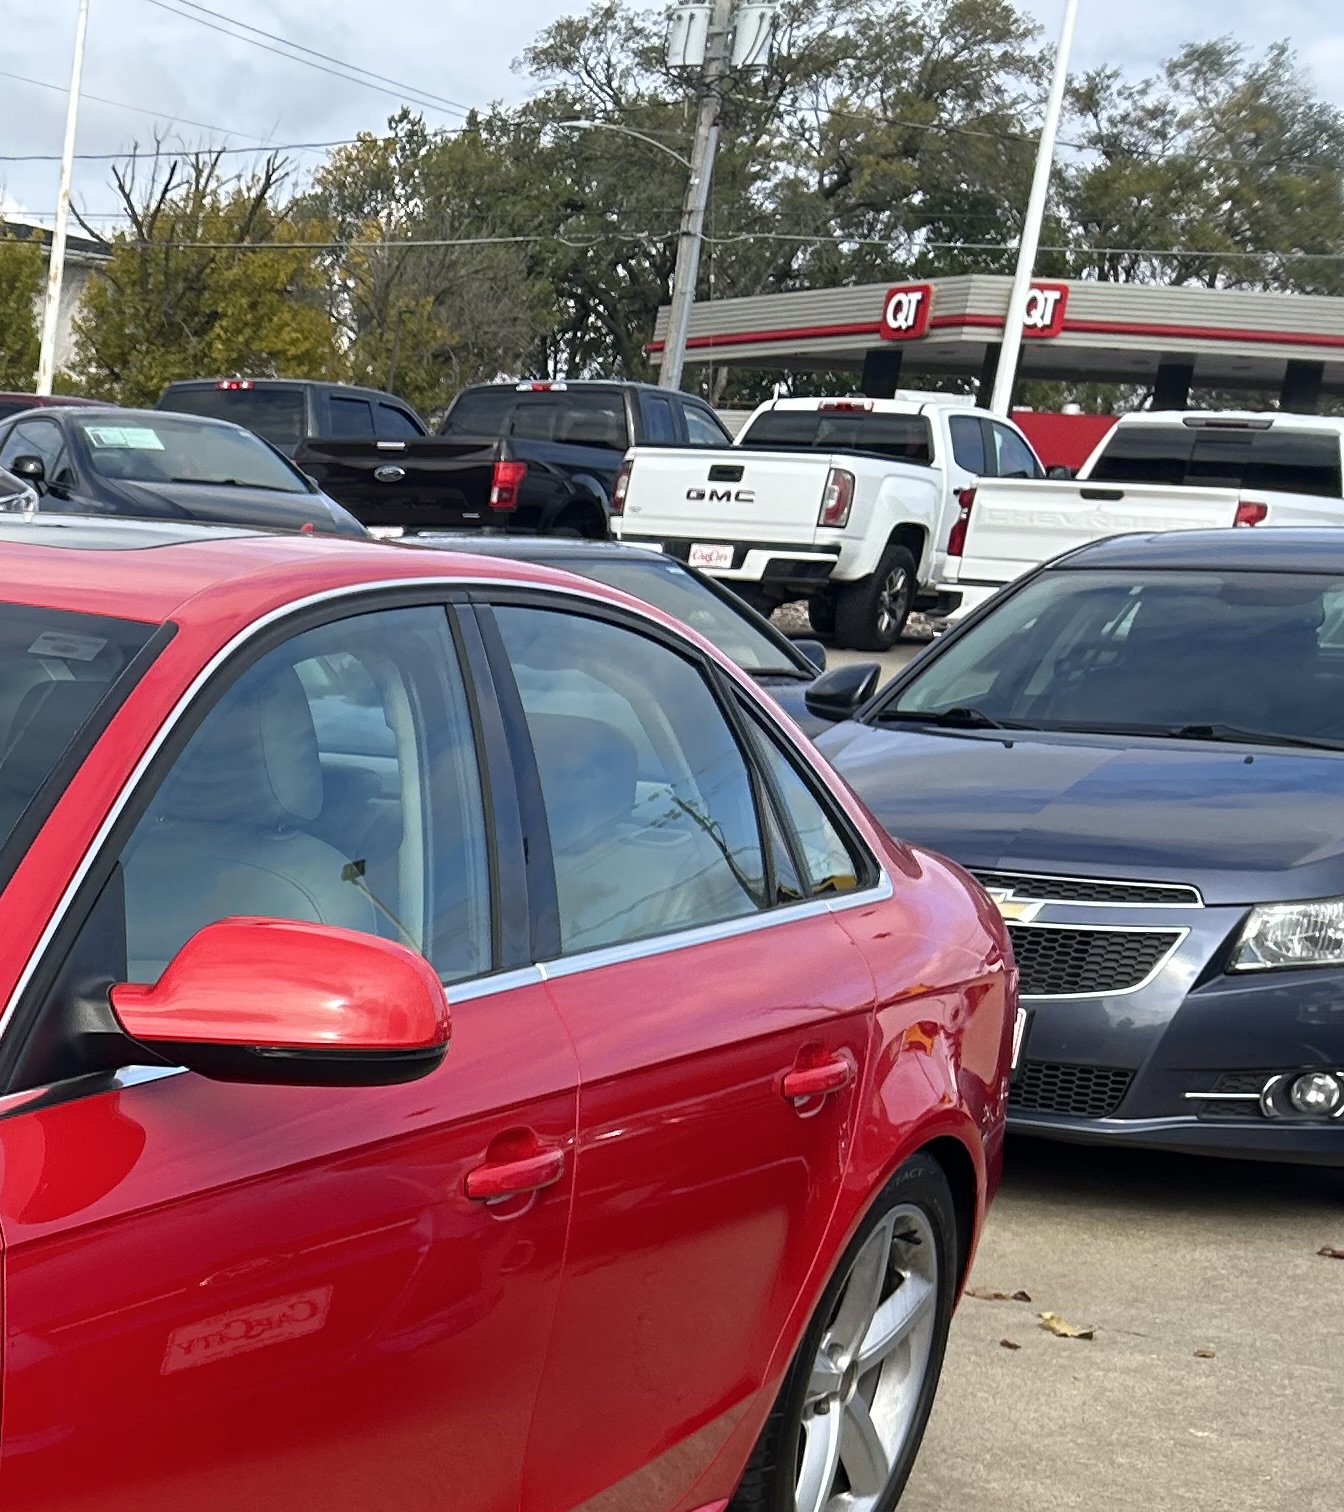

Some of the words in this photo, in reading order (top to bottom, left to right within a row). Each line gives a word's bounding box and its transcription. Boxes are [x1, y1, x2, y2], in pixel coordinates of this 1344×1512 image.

[886, 291, 922, 330] QT
[1023, 288, 1061, 328] QT
[686, 488, 755, 503] GMC
